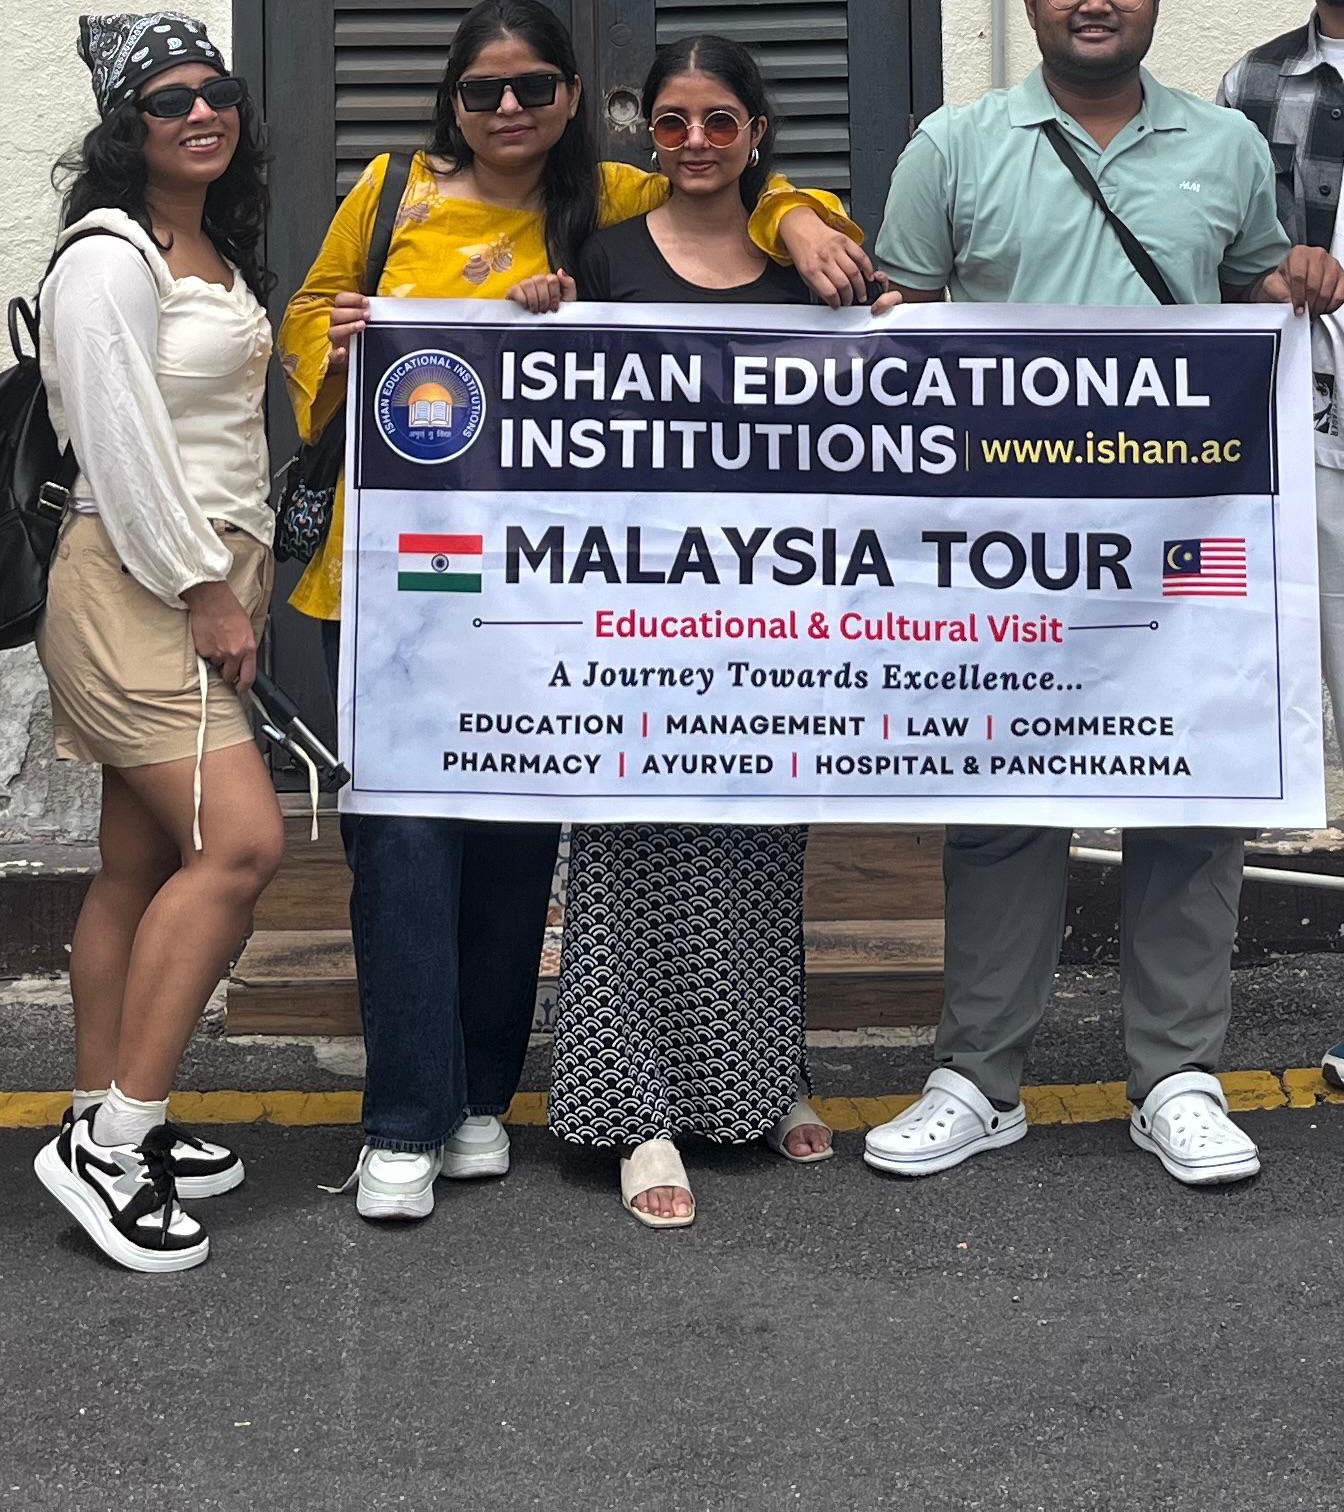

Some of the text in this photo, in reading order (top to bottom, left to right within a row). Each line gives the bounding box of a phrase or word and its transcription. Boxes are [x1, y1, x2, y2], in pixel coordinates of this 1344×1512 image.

[380, 355, 481, 439] ISHAN EDUCATIONAL INSTITUTIONS
[502, 351, 1210, 407] ISHAN EDUCATIONAL
[501, 418, 957, 474] INSTITUTIONS
[981, 431, 1242, 464] www.ishan.ac
[506, 526, 1132, 591] MALAYSIA TOUR
[596, 608, 1063, 644] Educational & Cultural Visit
[549, 660, 1083, 696] A Journey Towards Excellence...
[459, 712, 1174, 738] EDUCATION MANAGEMENT LAW COMMERCE
[442, 752, 1192, 777] PHARMACY AYURVED HOSPITAL & PANCHKARMA
